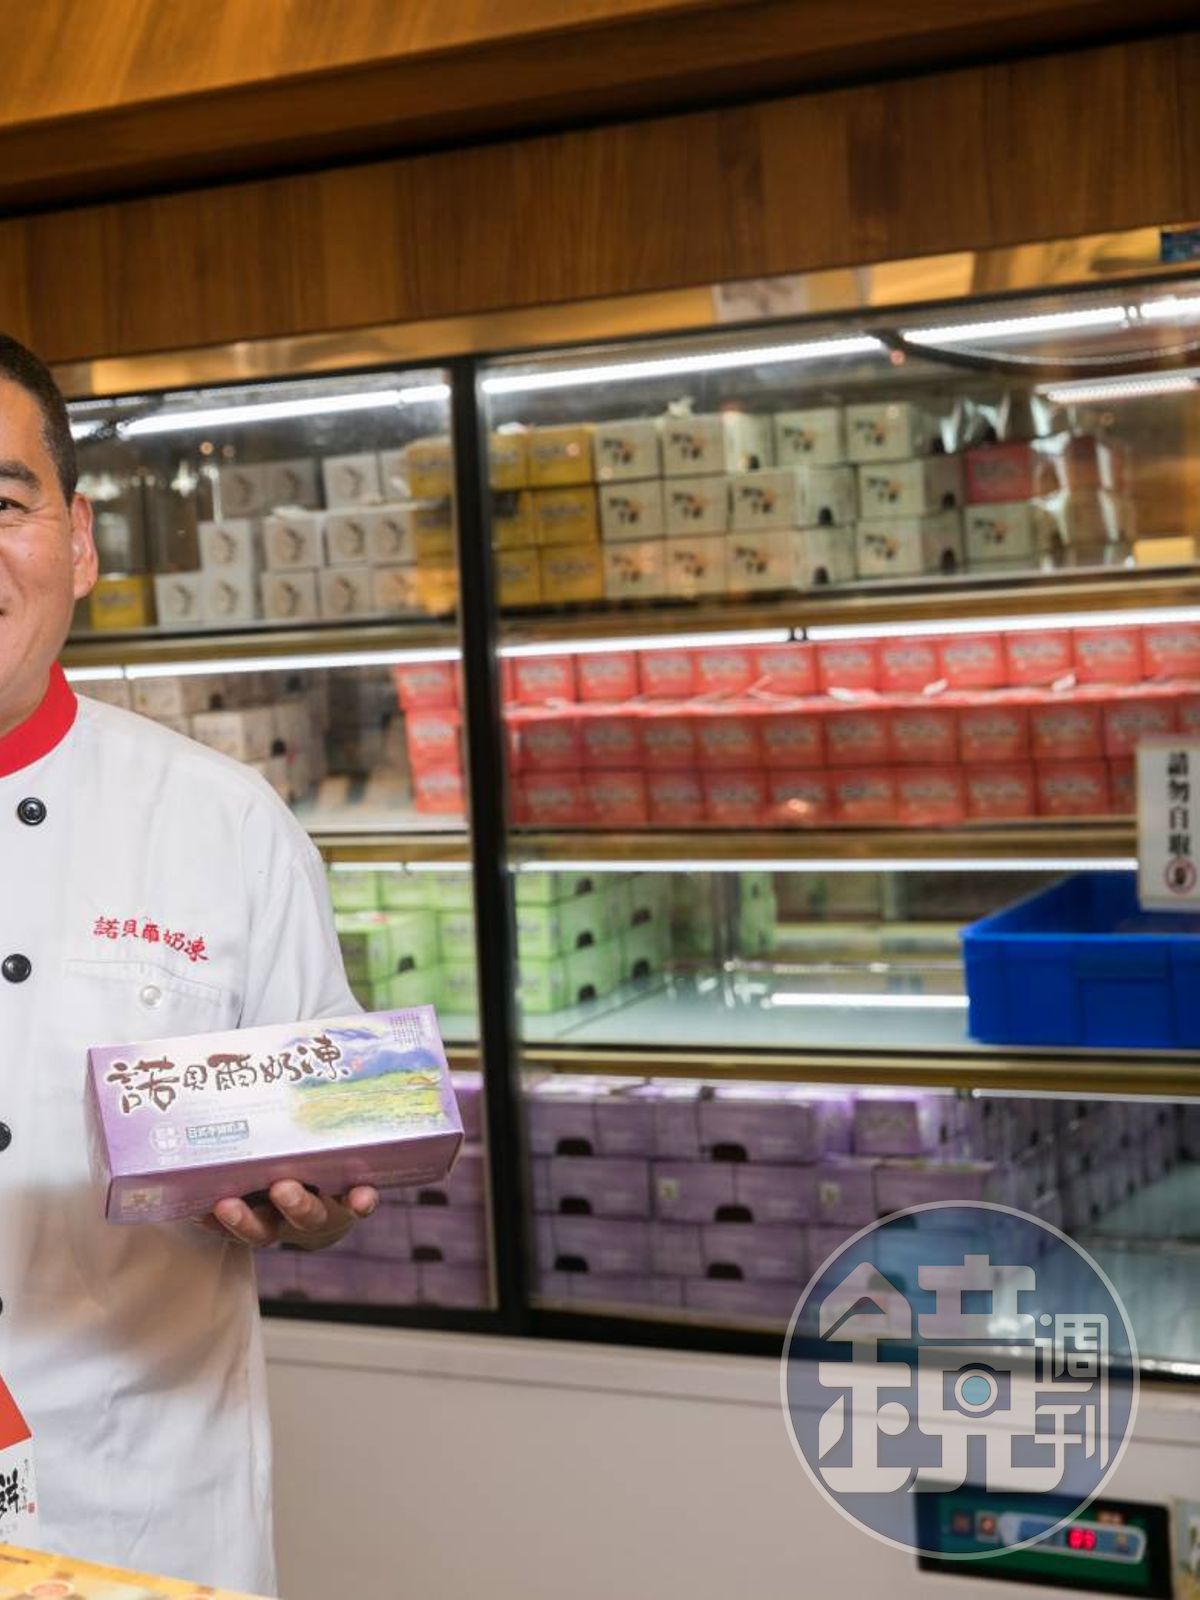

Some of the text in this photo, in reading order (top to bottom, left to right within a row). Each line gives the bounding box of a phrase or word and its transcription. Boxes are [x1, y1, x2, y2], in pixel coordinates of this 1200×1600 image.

[107, 1034, 349, 1114] 諾貝爾奶凍
